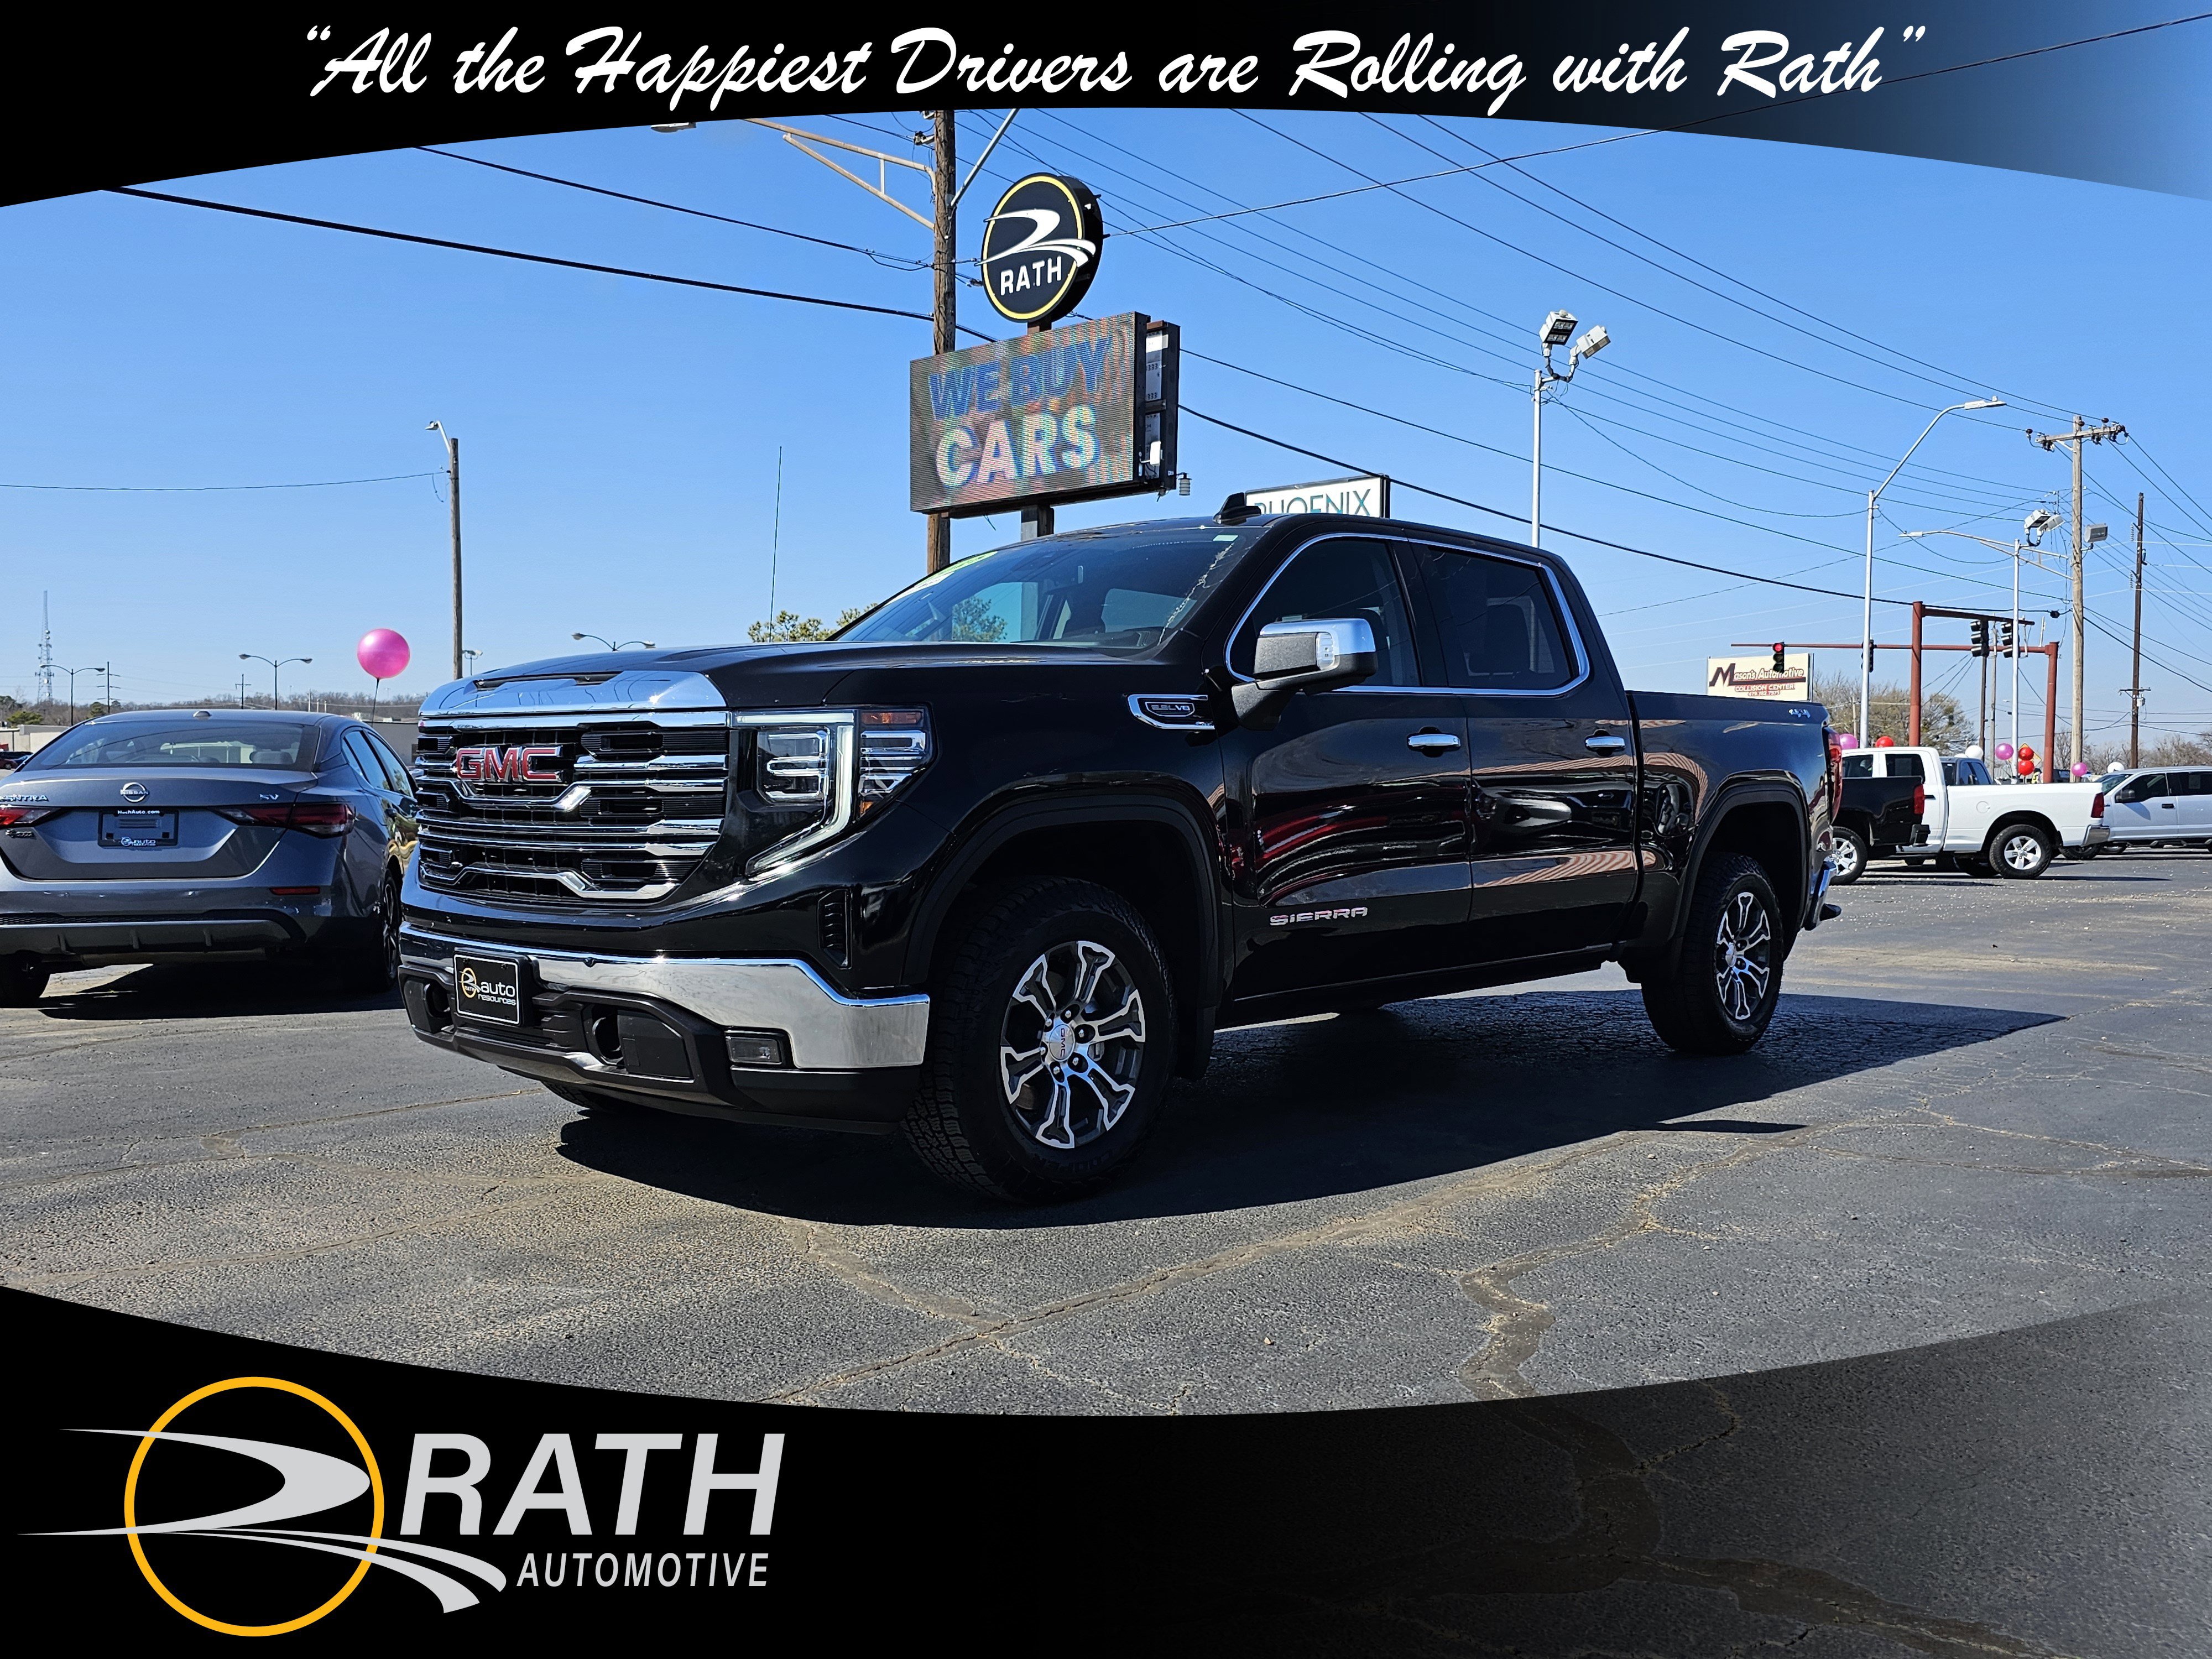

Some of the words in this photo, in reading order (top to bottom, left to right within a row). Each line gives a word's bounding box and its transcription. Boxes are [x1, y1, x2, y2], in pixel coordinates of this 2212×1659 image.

[1000, 255, 1062, 296] RATH
[928, 361, 1001, 421] WE
[1009, 336, 1112, 408] BUY
[936, 404, 1100, 488] CARS
[1709, 663, 1756, 686] Mason's
[456, 746, 563, 782] GMC
[1270, 906, 1368, 926] SIERRA
[478, 994, 517, 1006] resources
[481, 981, 516, 998] auto
